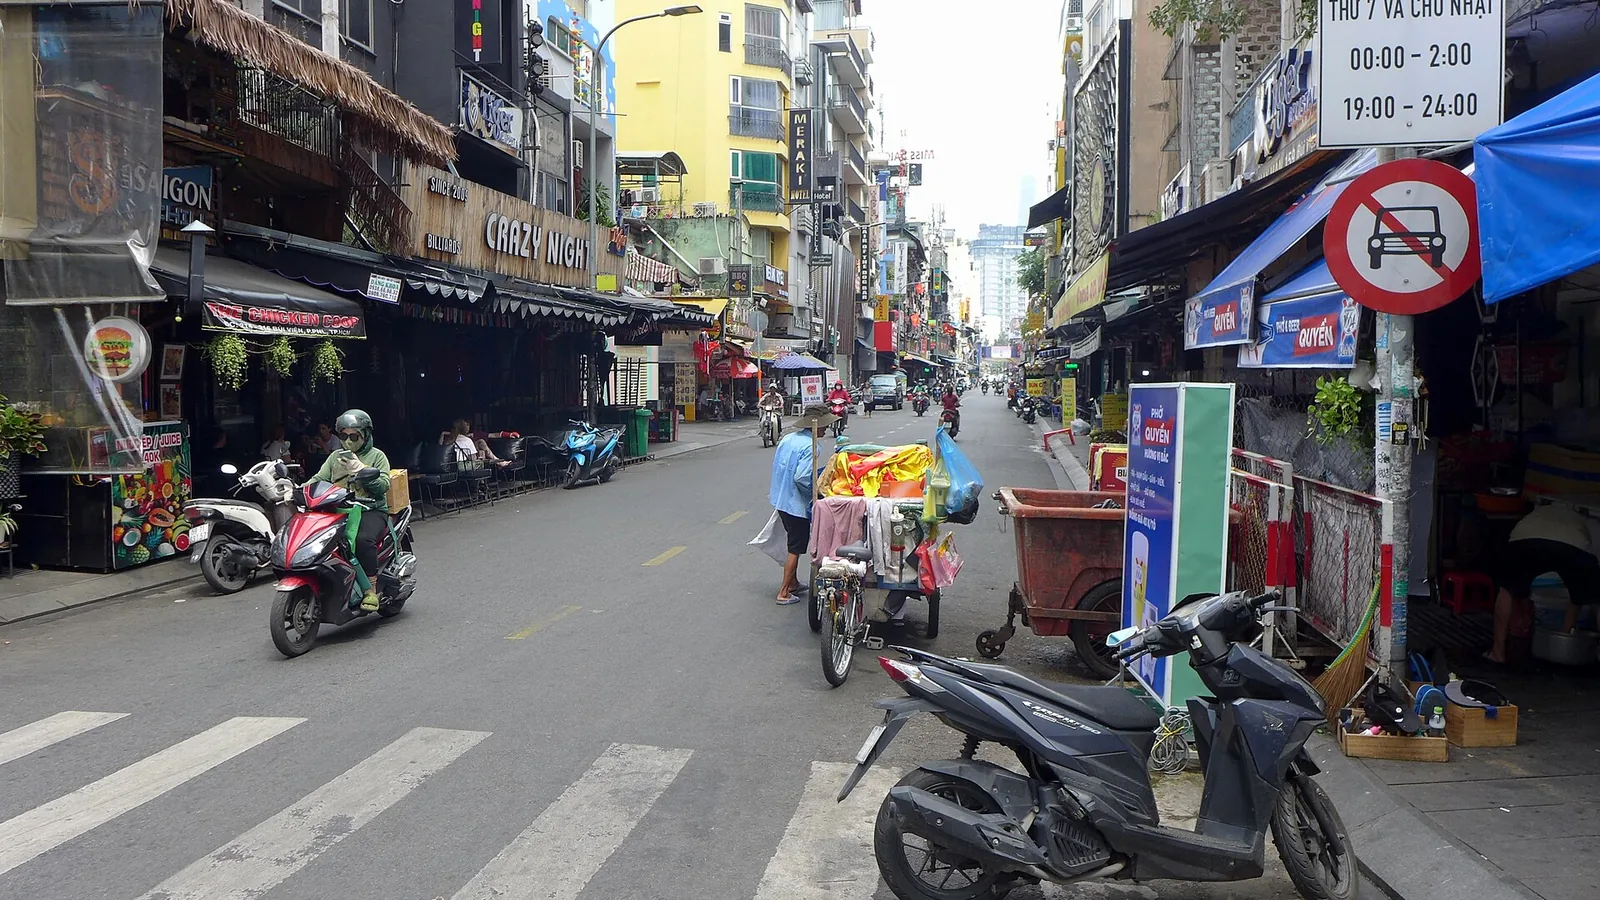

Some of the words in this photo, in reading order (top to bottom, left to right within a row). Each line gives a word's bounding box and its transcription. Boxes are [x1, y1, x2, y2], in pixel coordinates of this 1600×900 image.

[1367, 0, 1376, 20] 7
[1350, 45, 1404, 71] 00:00
[1429, 42, 1471, 68] 2:00
[1343, 96, 1395, 121] 19:00
[1422, 92, 1477, 118] 24:00
[794, 113, 807, 186] MERAKI
[134, 165, 211, 211] SAIGON
[430, 178, 450, 198] SINCE
[814, 192, 831, 200] Hotel
[427, 233, 461, 255] BILLIARDS
[486, 212, 542, 260] CRAZY
[731, 272, 747, 281] BBQ
[207, 302, 242, 319] THE
[248, 307, 319, 327] CHICKEN
[323, 314, 359, 329] COOP
[1289, 318, 1300, 332] BEER
[160, 433, 181, 446] JUICE
[144, 450, 160, 463] 40K
